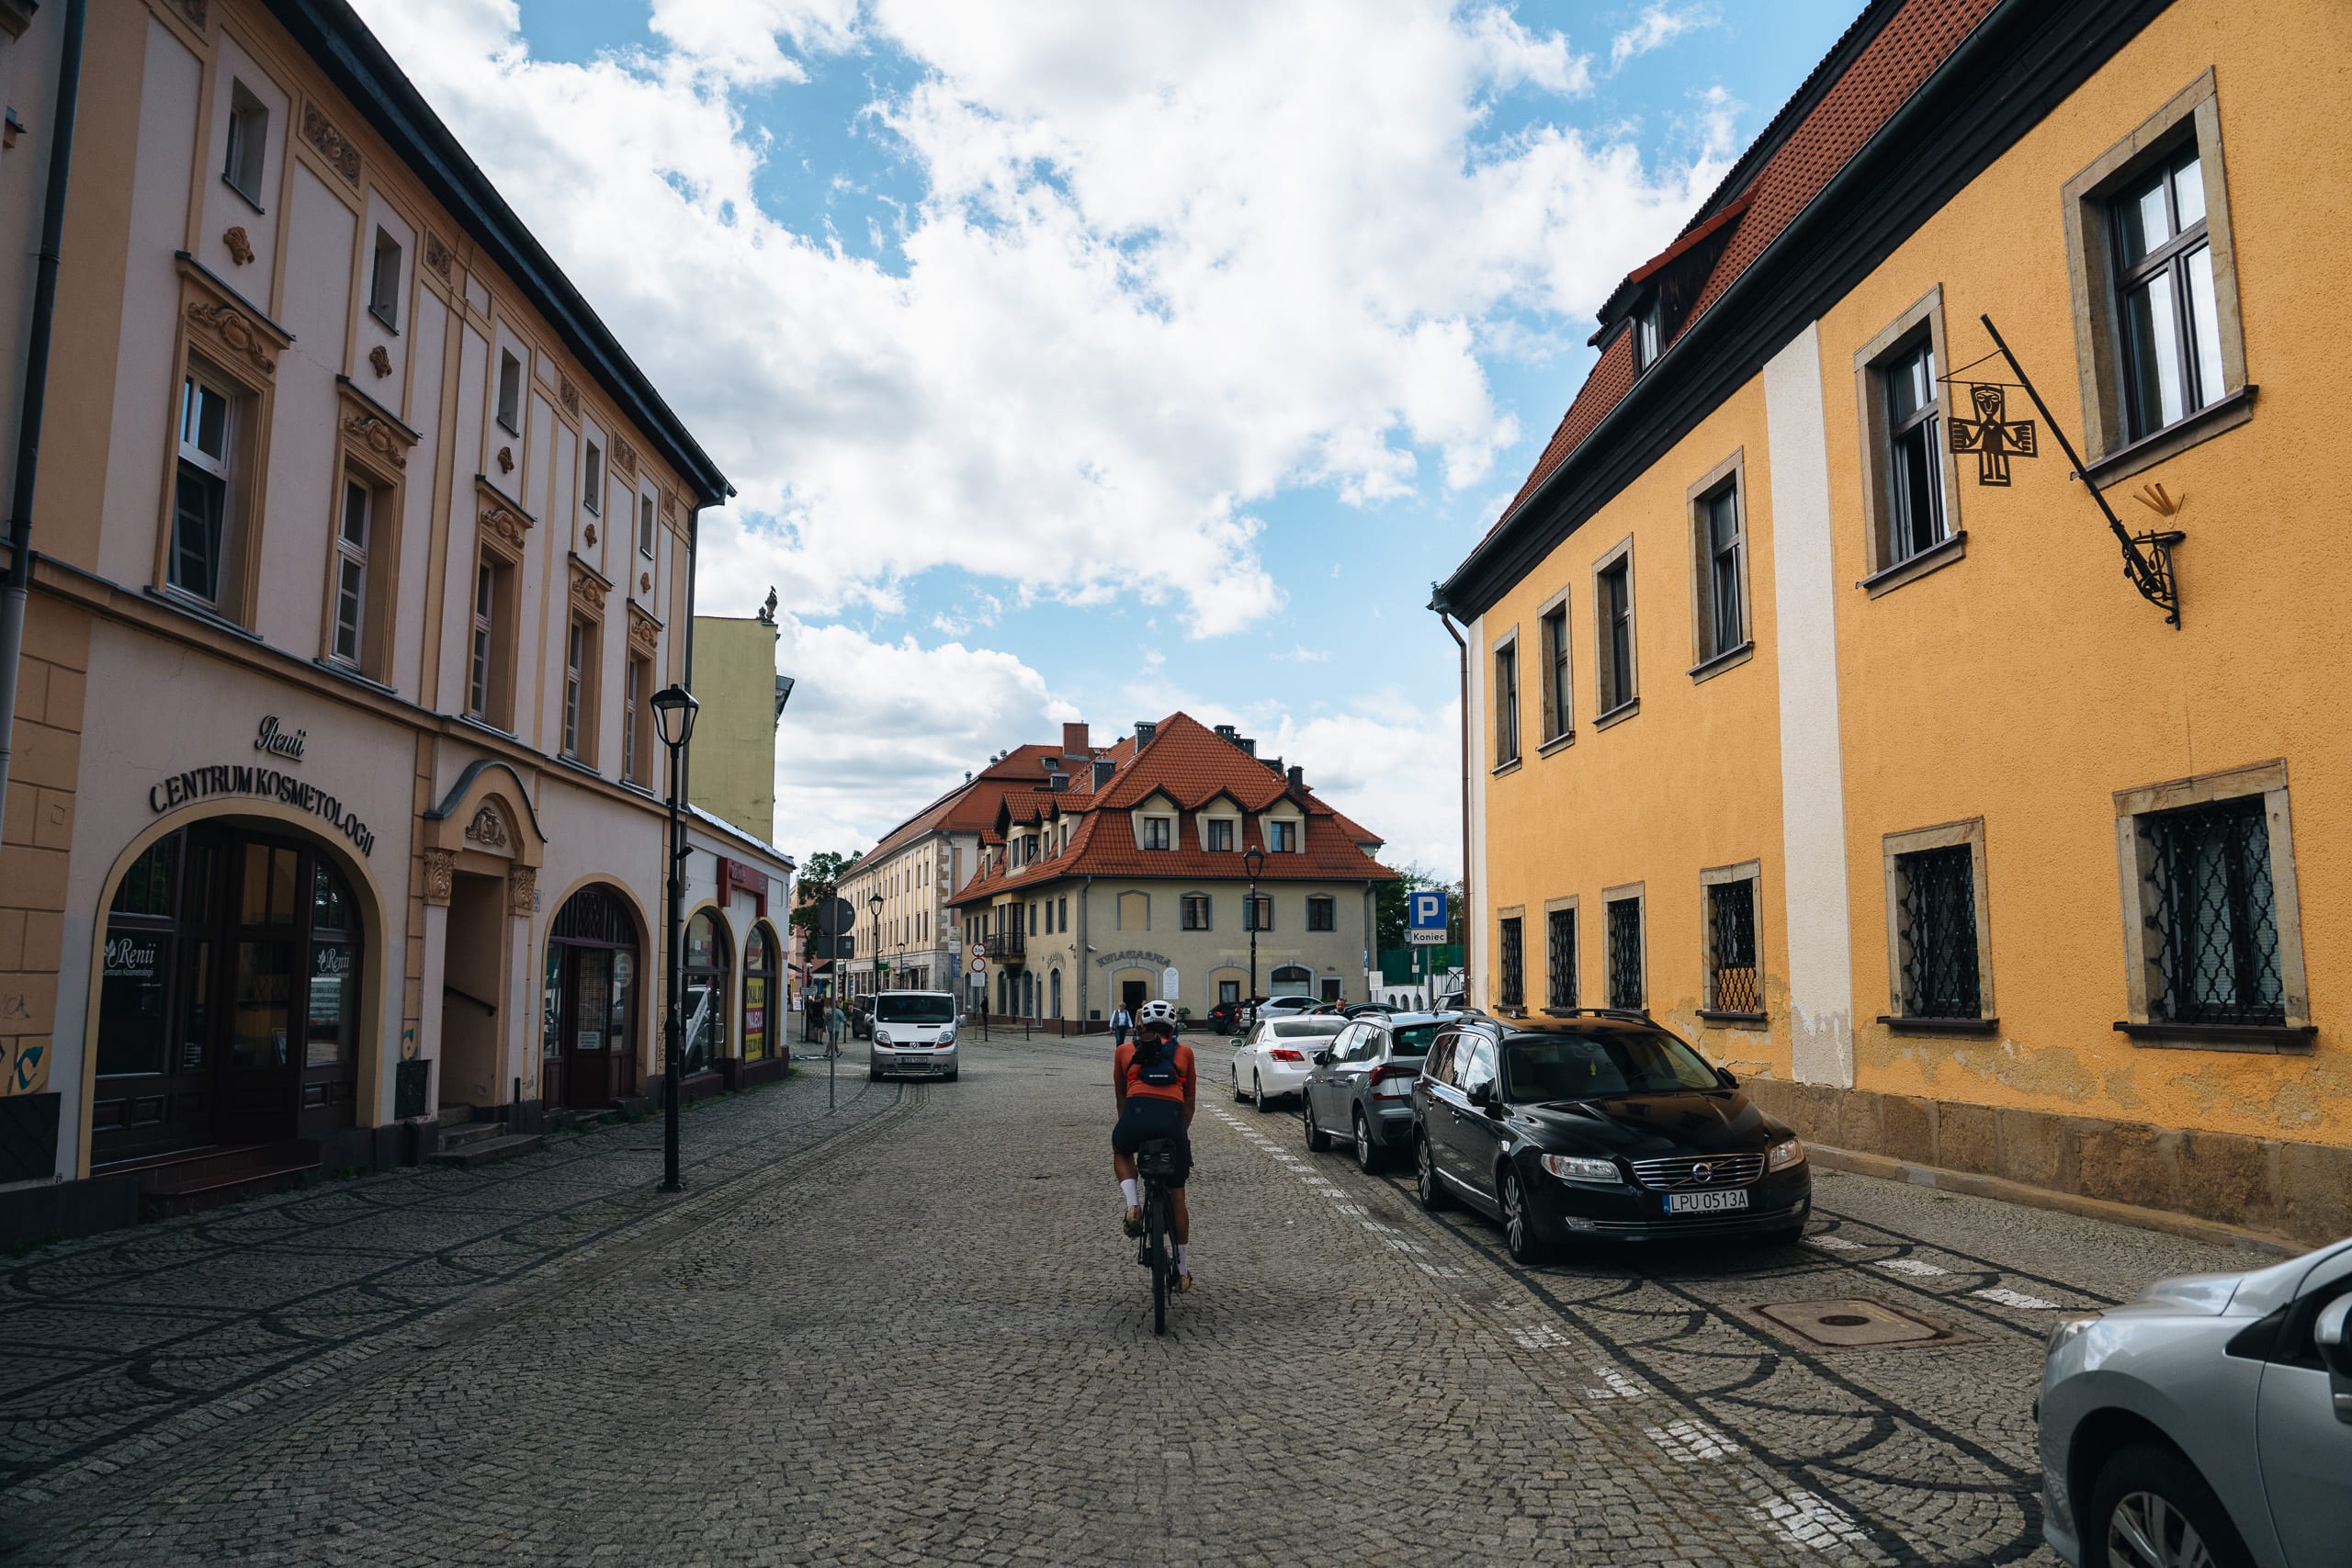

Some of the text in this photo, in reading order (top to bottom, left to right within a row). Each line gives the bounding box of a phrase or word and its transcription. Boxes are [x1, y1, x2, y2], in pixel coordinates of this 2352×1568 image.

[150, 765, 375, 857] CENTRUM KOSMETOLOGII
[1419, 897, 1438, 924] P
[107, 938, 156, 968] Renii
[320, 948, 351, 973] Renii
[1671, 1191, 1747, 1211] LPU 0513A
